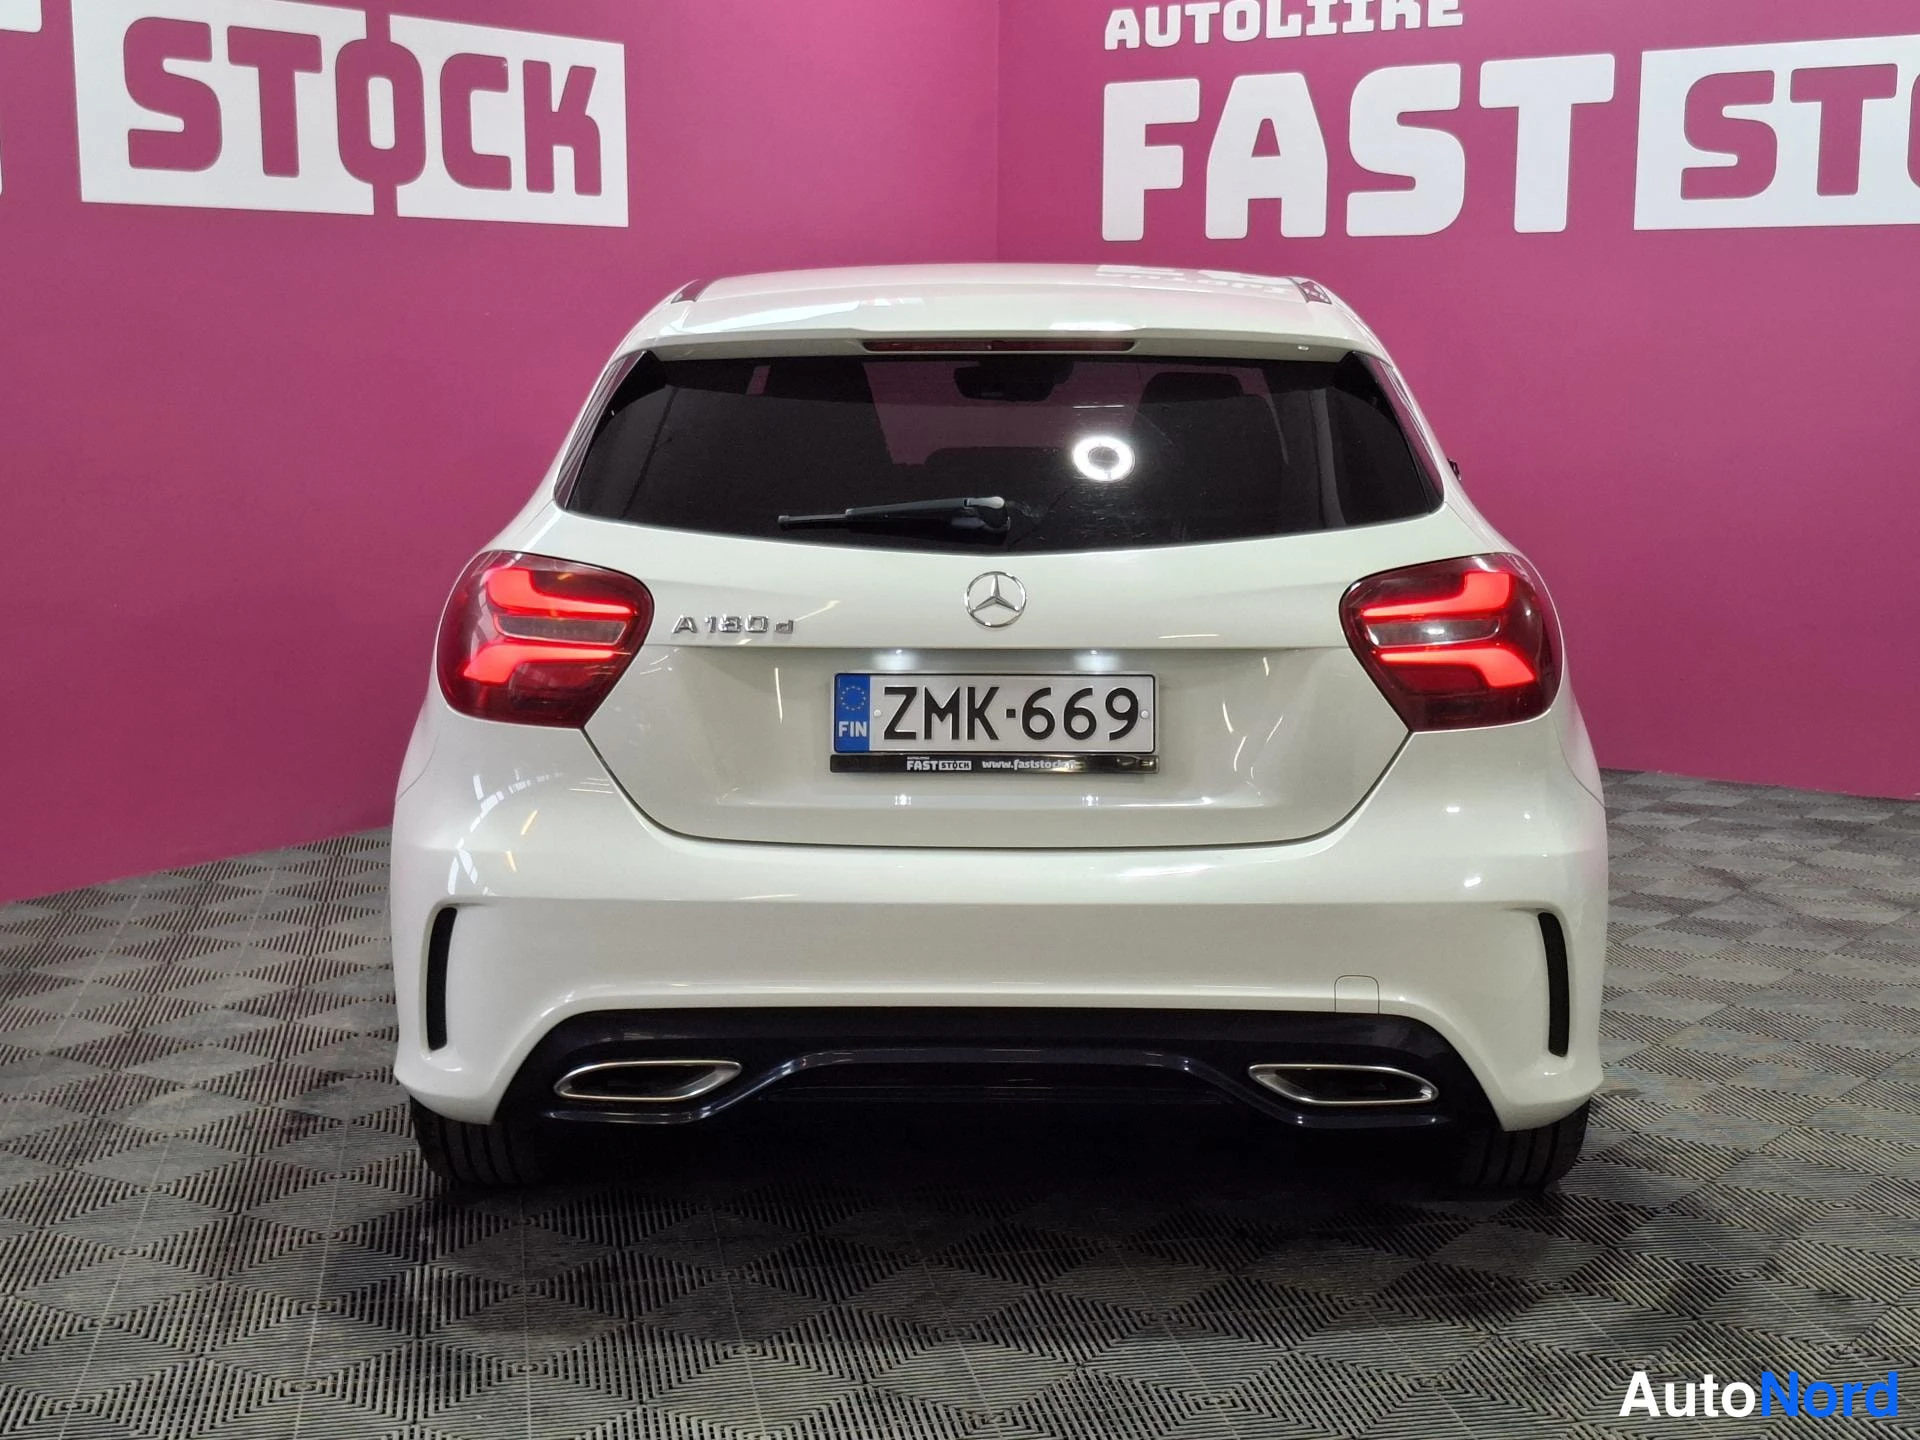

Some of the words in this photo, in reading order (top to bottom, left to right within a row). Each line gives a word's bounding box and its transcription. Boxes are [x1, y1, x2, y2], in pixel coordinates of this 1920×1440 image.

[1104, 0, 1464, 50] AUTOLIIKE
[123, 16, 602, 196] STOCK
[1102, 53, 1616, 241] FAST
[1680, 64, 1920, 200] ST
[672, 615, 698, 633] A
[704, 614, 769, 633] 180
[838, 721, 867, 737] FIN
[906, 760, 938, 771] FAST
[941, 761, 970, 769] STOCK
